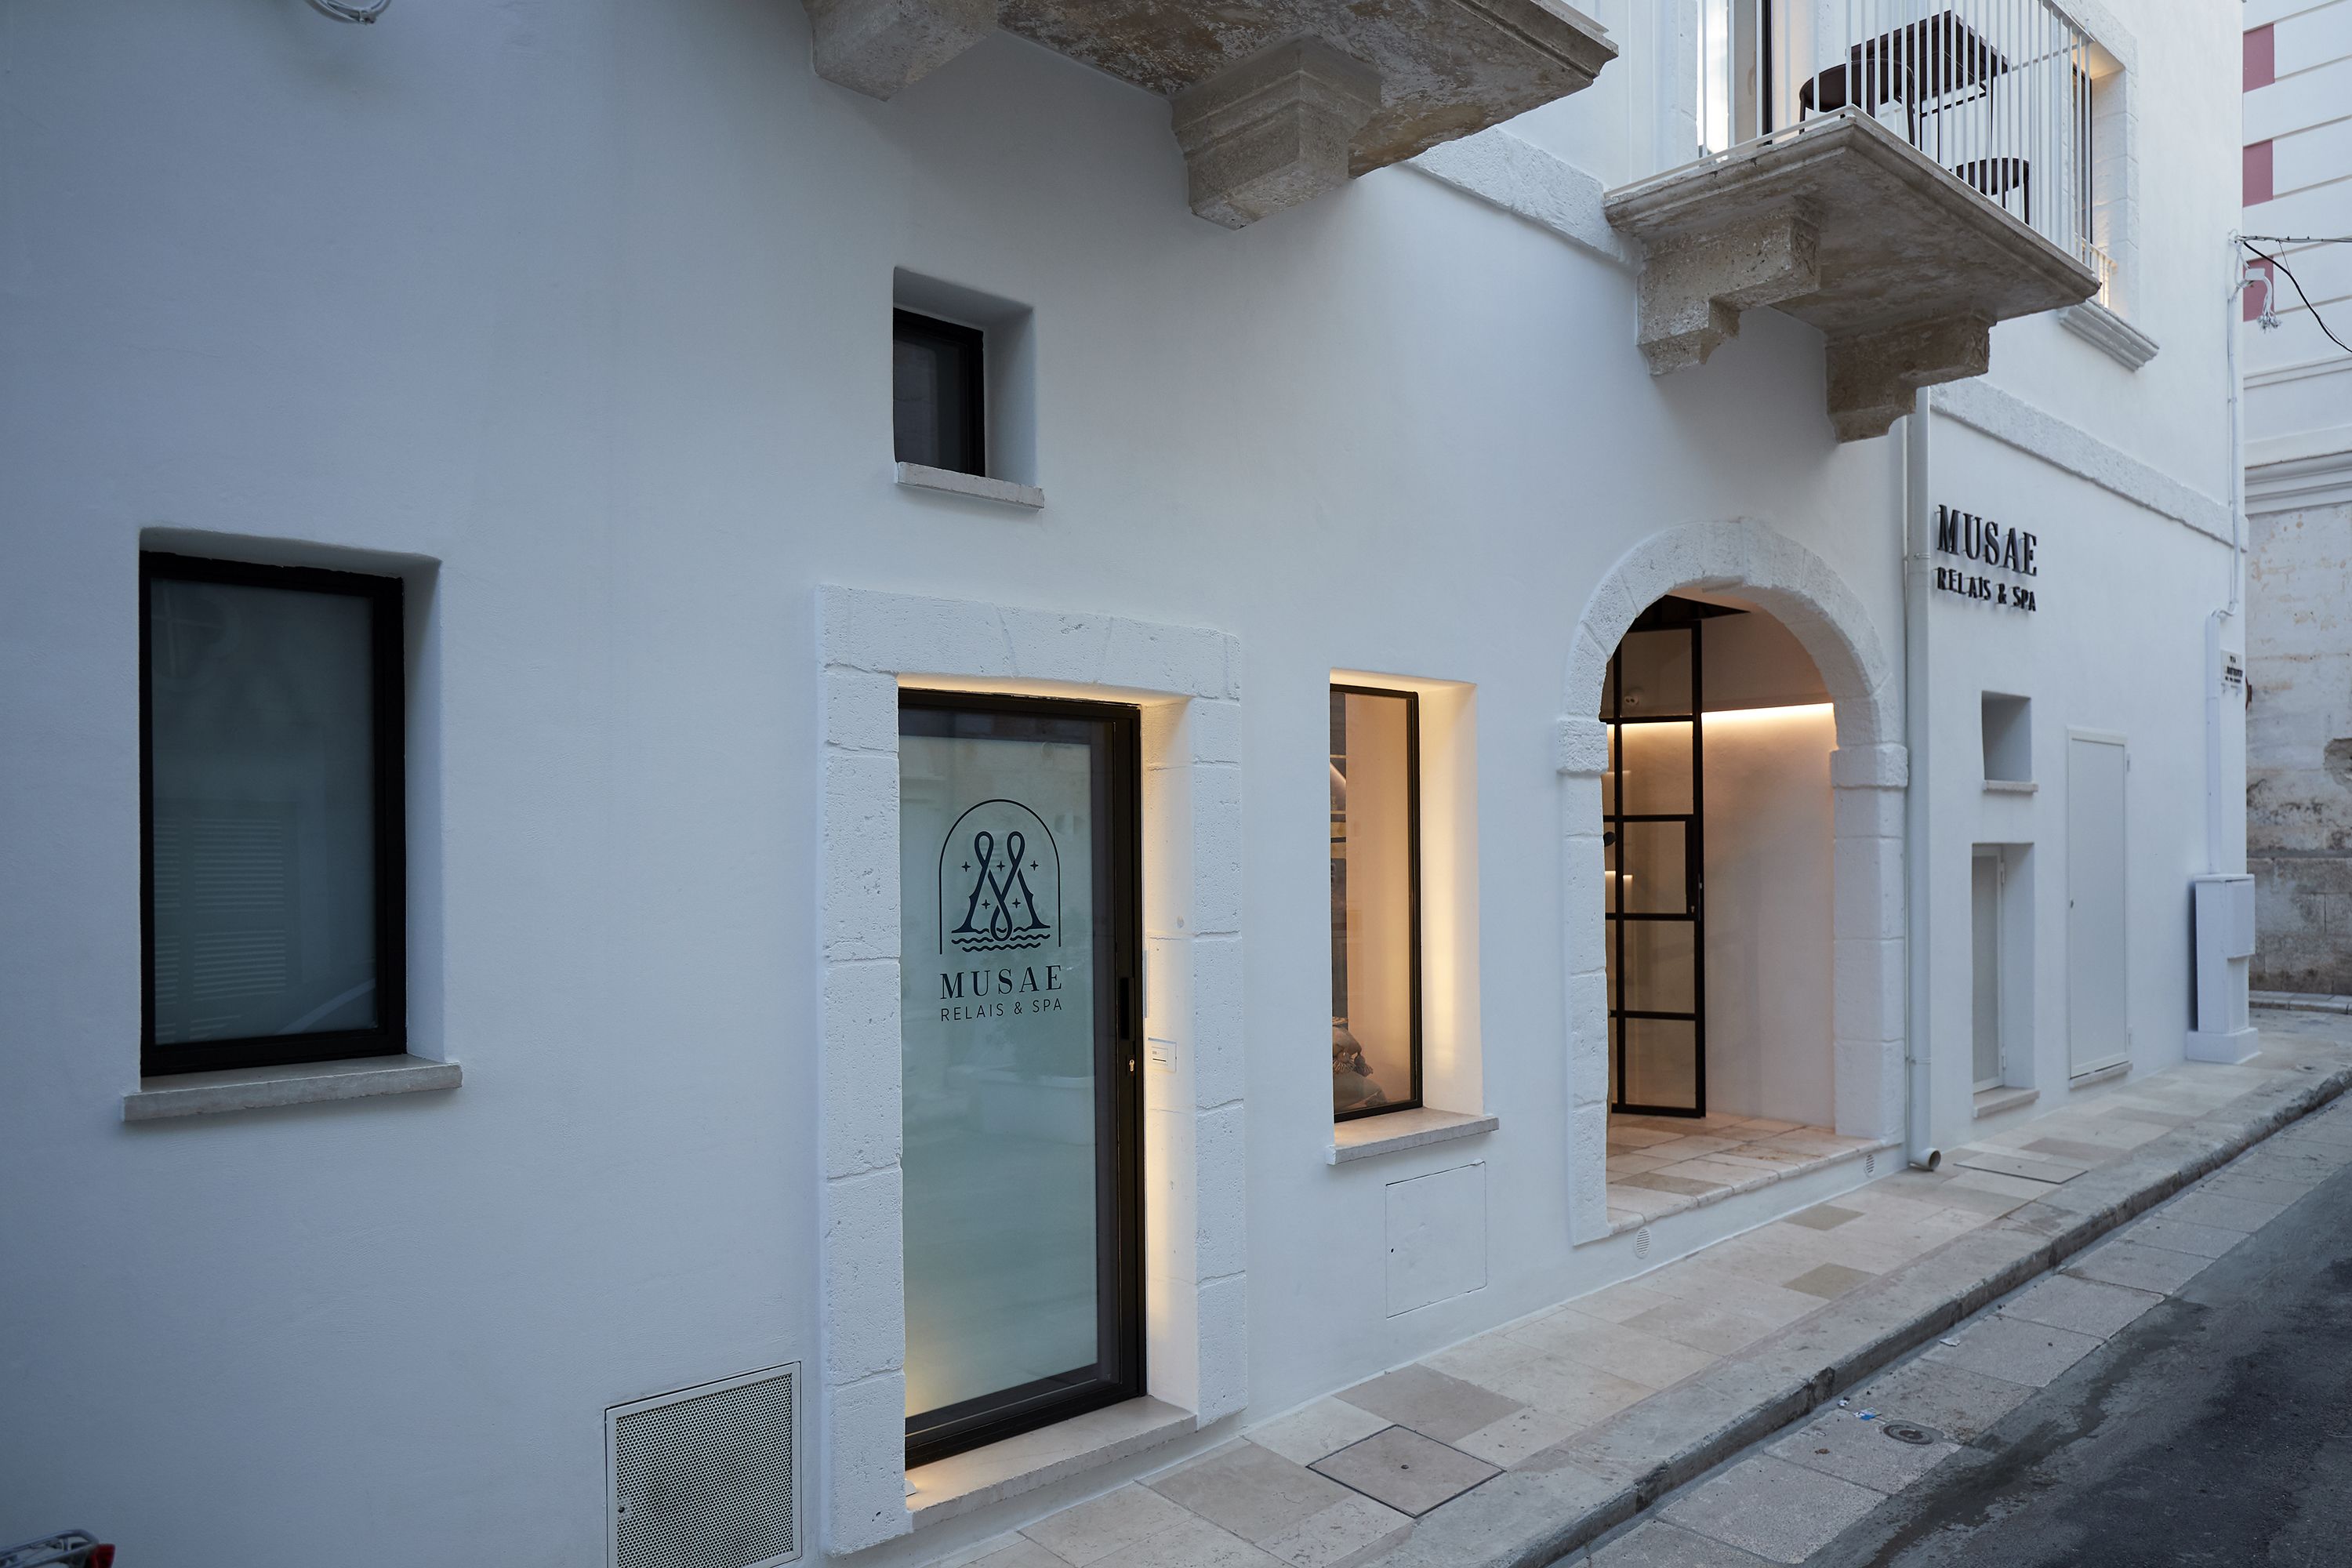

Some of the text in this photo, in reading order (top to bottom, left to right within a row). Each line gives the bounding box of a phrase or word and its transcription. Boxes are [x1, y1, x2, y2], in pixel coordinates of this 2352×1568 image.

[1936, 504, 2037, 576] MUSAE
[1937, 567, 2036, 612] RELAIS & SPA
[940, 965, 1062, 1000] MUSAE
[941, 998, 1062, 1022] RELAIS & SPA
